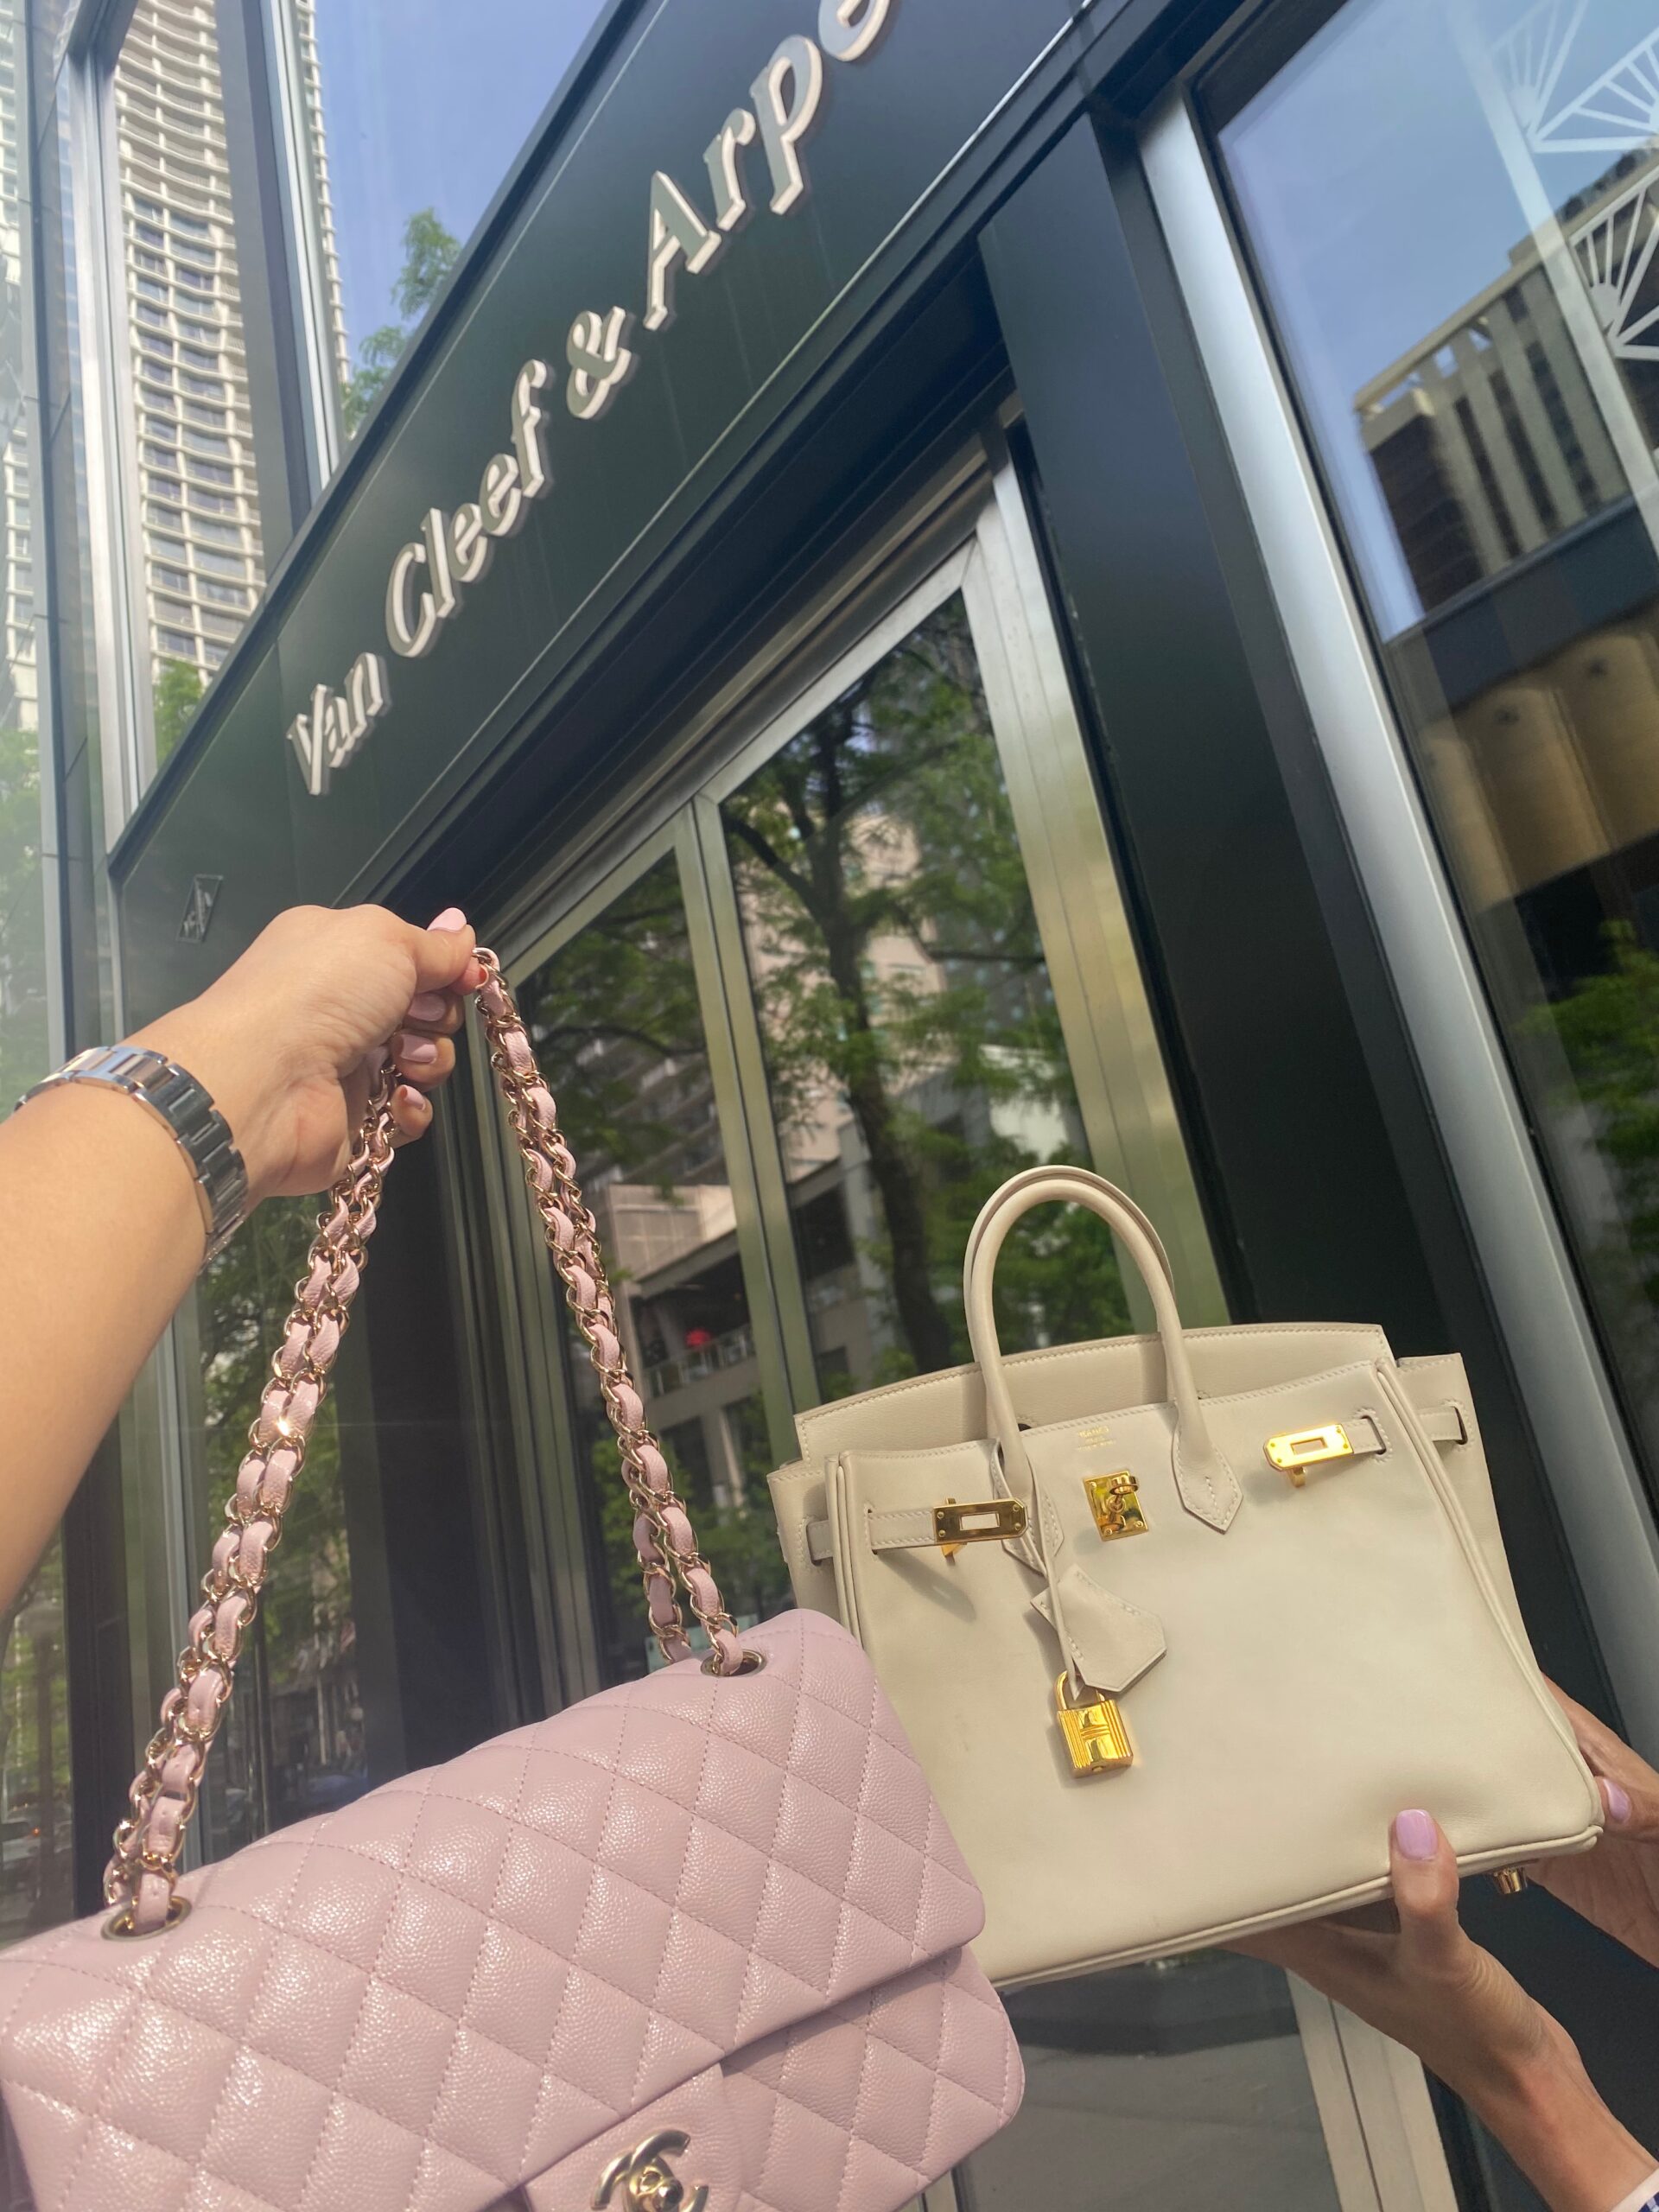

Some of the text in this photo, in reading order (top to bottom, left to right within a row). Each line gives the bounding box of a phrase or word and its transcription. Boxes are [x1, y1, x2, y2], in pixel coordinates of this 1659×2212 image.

[286, 652, 385, 796] Van
[385, 359, 548, 658] Cleef
[566, 306, 632, 420] &
